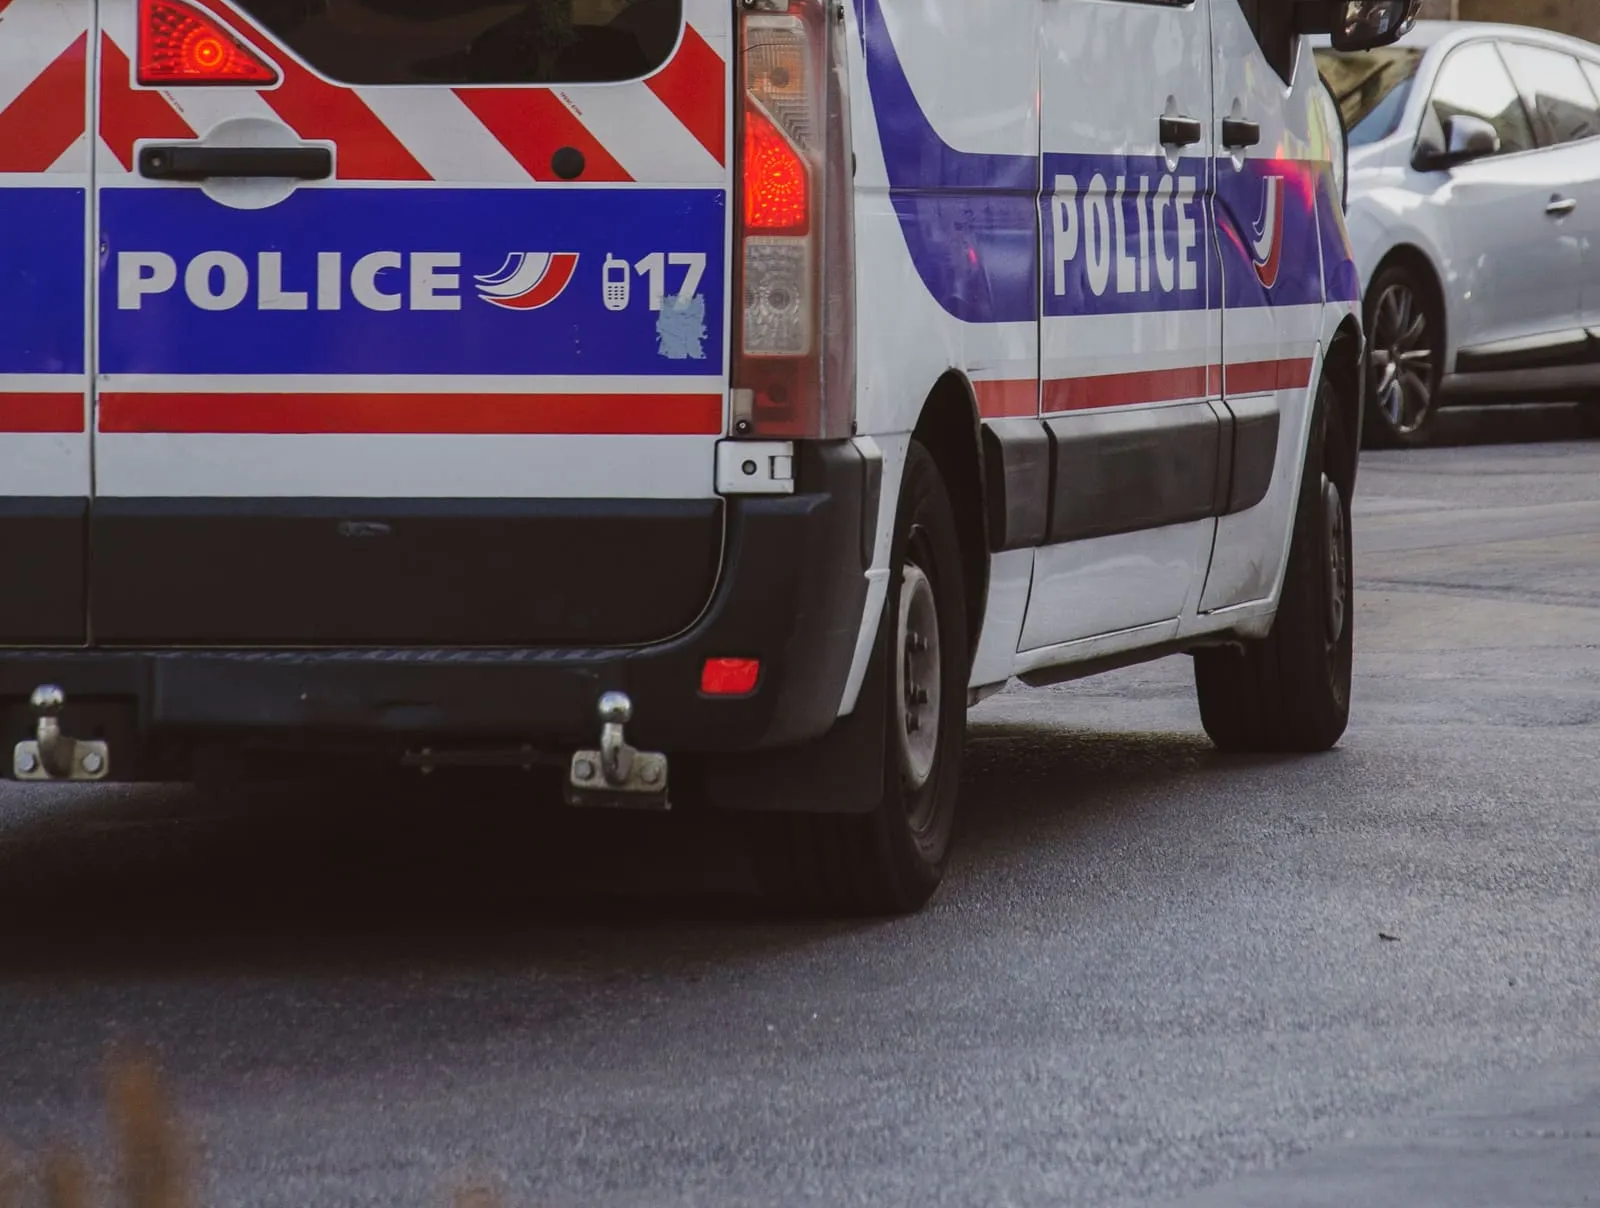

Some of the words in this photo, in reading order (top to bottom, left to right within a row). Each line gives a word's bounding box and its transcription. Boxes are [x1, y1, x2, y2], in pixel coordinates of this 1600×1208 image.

[117, 250, 461, 310] POLICE
[634, 252, 707, 310] 17
[1051, 173, 1197, 296] POLICE
